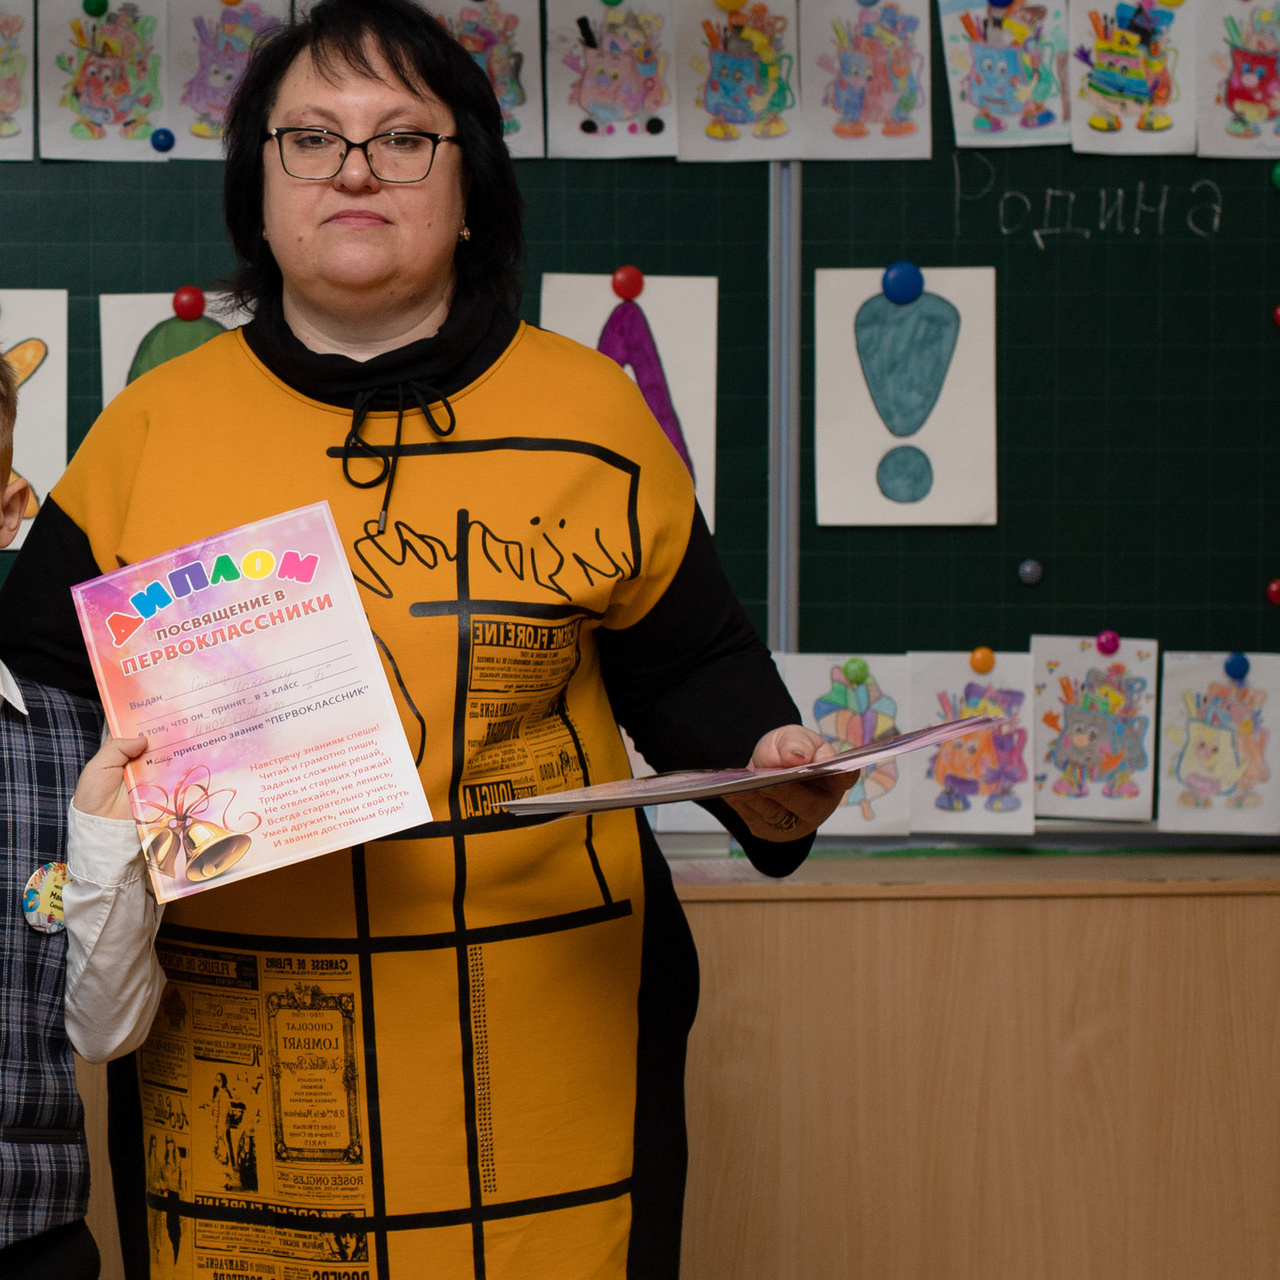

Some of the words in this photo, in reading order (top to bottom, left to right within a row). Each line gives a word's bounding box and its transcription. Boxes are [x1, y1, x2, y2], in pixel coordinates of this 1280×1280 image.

[952, 151, 1221, 249] Родина
[105, 549, 320, 648] ДИПЛОМ
[156, 594, 271, 641] ПОСВЯЩЕНИЕ
[275, 589, 286, 602] В
[121, 593, 334, 677] ПЕРВОКЛАССНИКИ
[129, 694, 163, 710] Выдан
[147, 725, 170, 737] том,
[171, 717, 189, 726] что
[272, 681, 299, 695] класс
[173, 734, 227, 758] присвоено
[229, 721, 265, 740] звание
[250, 750, 300, 772] Навстречу
[303, 737, 344, 755] знаниям
[346, 724, 380, 741] спеши!
[259, 766, 289, 780] Читай
[300, 749, 346, 768] грамотно
[348, 738, 378, 753] пиши,
[258, 788, 298, 805] Трудись
[309, 772, 350, 790] старших
[352, 757, 392, 777] уважай!
[260, 776, 301, 793] Задачки
[303, 760, 346, 779] сложные
[349, 748, 384, 767] решай,
[264, 805, 278, 815] Не
[280, 787, 340, 811] отвлекайся,
[341, 784, 353, 792] не
[356, 772, 393, 788] ленись,
[262, 826, 288, 840] Умей
[291, 814, 337, 833] дружить,
[339, 806, 360, 817] ищи
[362, 797, 385, 809] свой
[387, 790, 409, 802] путь
[267, 811, 300, 826] Всегда
[303, 792, 363, 816] старательно
[365, 783, 397, 800] учись,
[273, 840, 282, 848] И
[284, 831, 318, 845] звания
[321, 812, 376, 836] достойным
[378, 802, 405, 816] будь!
